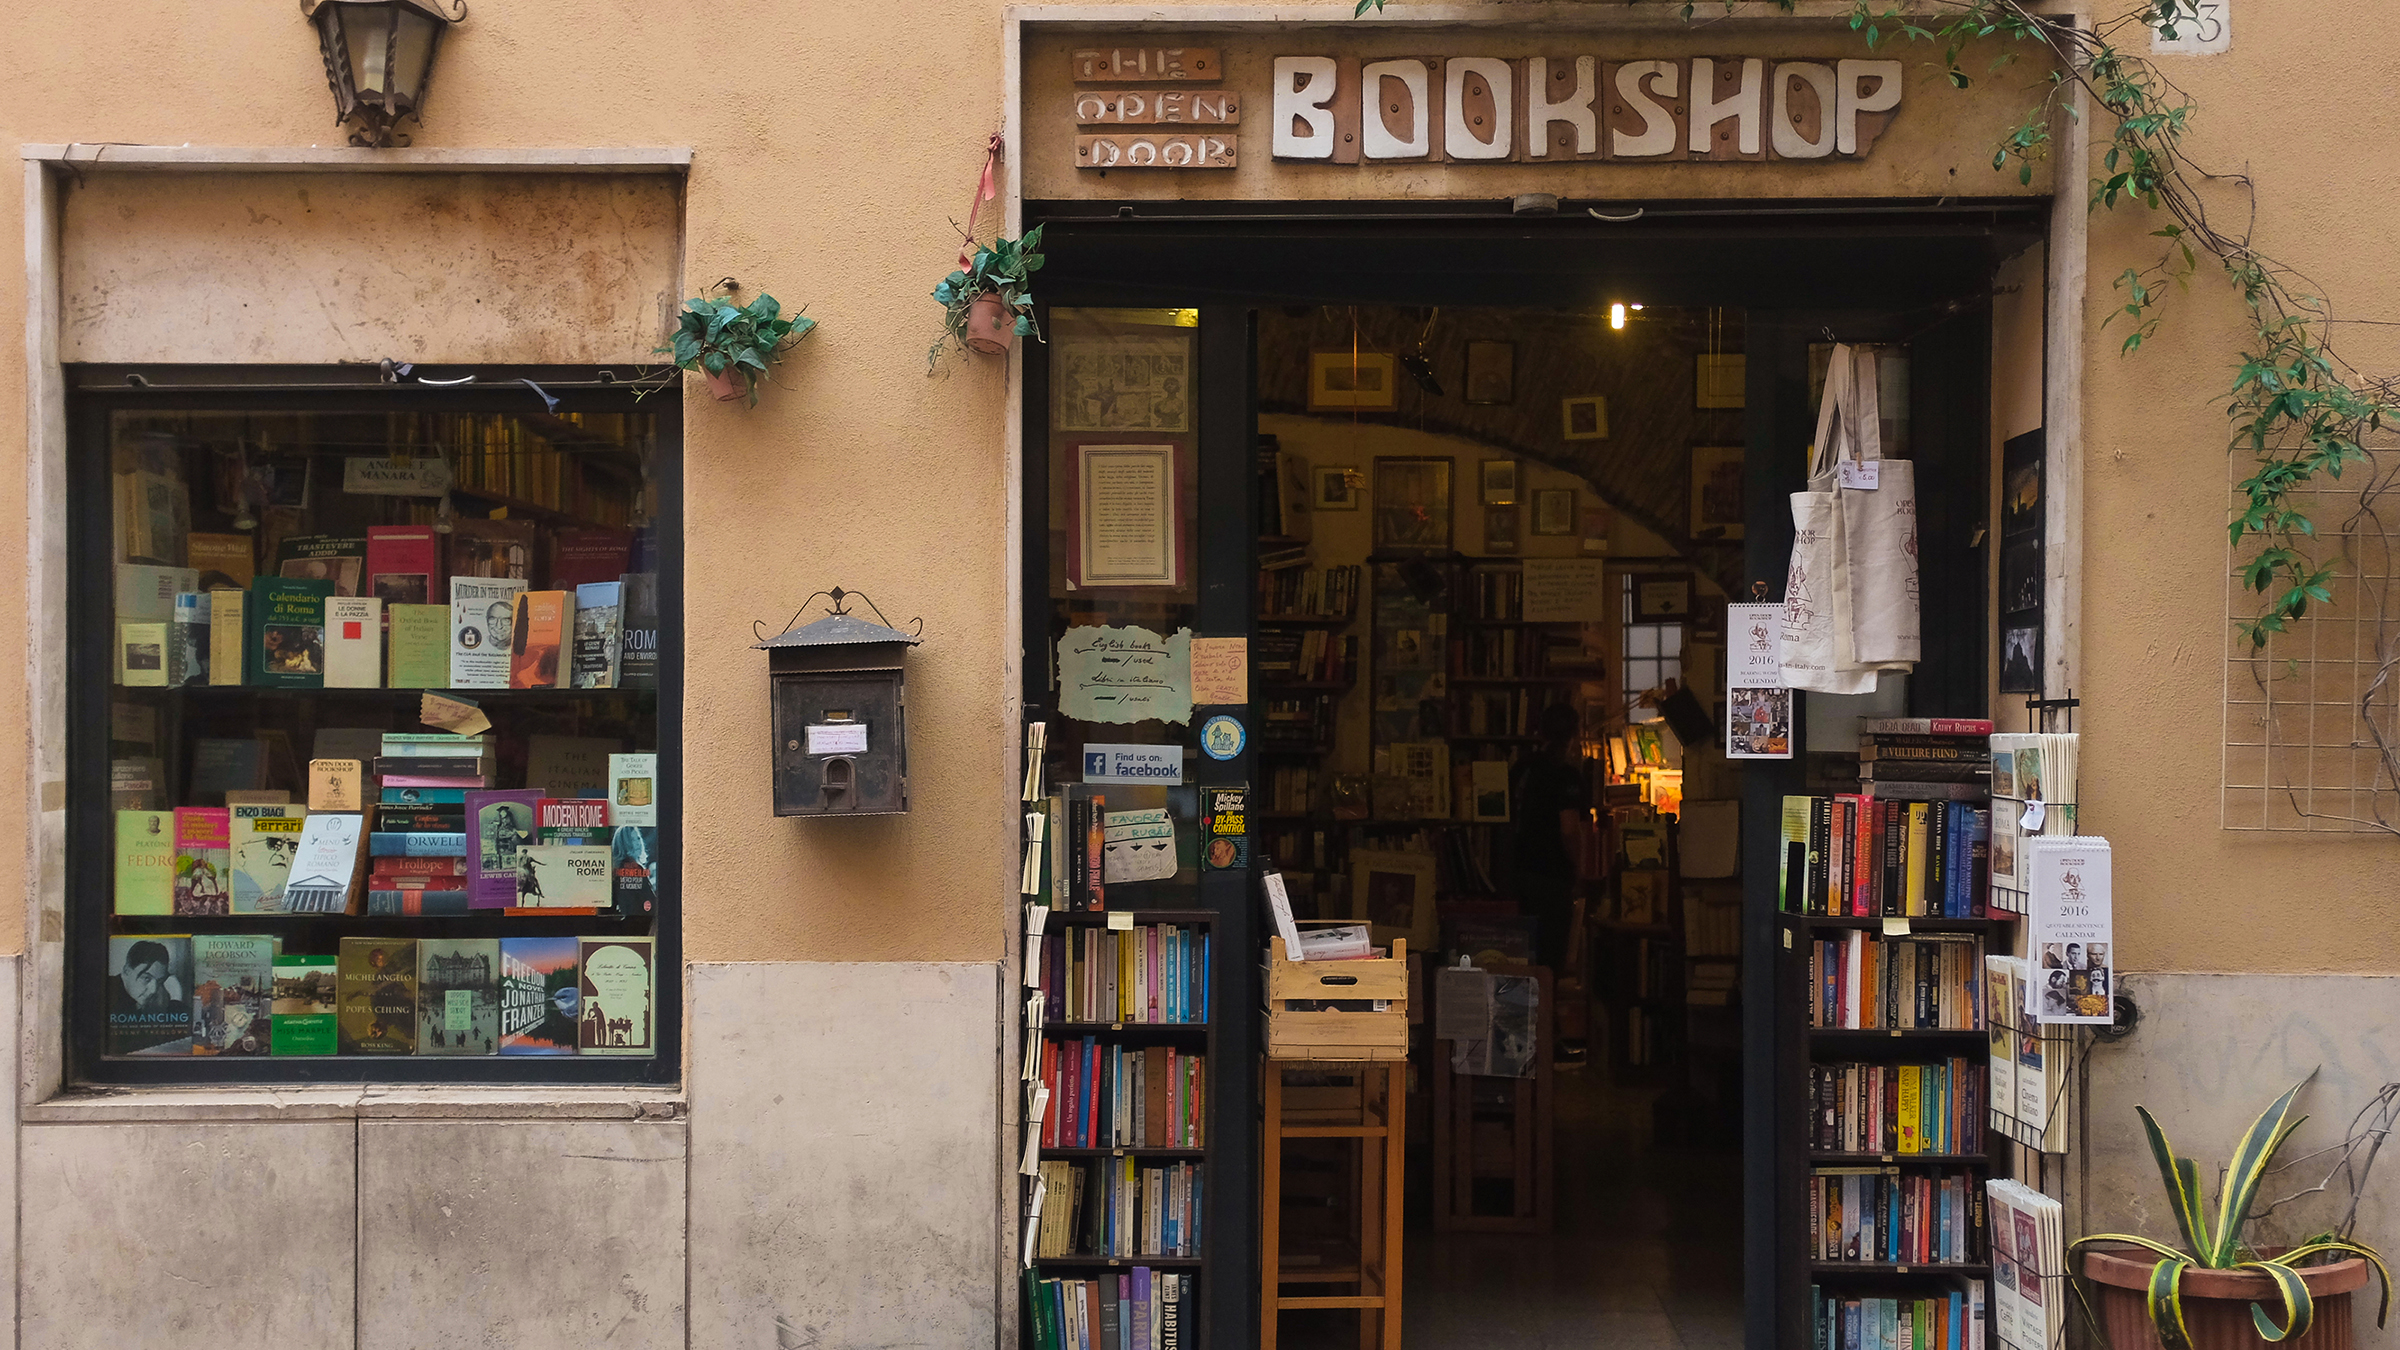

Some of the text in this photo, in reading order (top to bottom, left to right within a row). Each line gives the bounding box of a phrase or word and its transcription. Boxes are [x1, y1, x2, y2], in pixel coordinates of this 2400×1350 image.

[1076, 49, 1187, 78] THE
[1077, 93, 1226, 122] OPEN
[1272, 55, 1903, 160] BOOKSHOP
[1092, 137, 1228, 167] DOOR
[360, 471, 416, 480] MANARA
[297, 542, 356, 552] TRASTEVERE
[269, 592, 321, 603] Calendario
[455, 582, 499, 600] MURDER IN THE
[274, 603, 315, 615] di Roma
[624, 629, 657, 650] ROM
[1092, 637, 1151, 652] English books
[623, 652, 635, 660] AND
[1749, 655, 1774, 665] 2016
[1091, 671, 1164, 685] Libri italiano
[1901, 721, 1977, 733] DEAD KATHY REICHS
[565, 752, 587, 761] THE
[1115, 753, 1134, 762] Find
[1149, 754, 1163, 763] on:
[1888, 746, 1959, 759] VULTURE FUND
[548, 767, 601, 775] ITALIAN
[1114, 762, 1178, 777] facebook
[549, 780, 598, 789] CINEMA
[1216, 793, 1244, 803] Mickey
[236, 807, 259, 817] ENZO
[261, 807, 284, 817] BIAGI
[1214, 802, 1245, 812] Spillane
[1822, 801, 1831, 825] NEMESIS
[543, 805, 603, 827] MODERN ROME
[1110, 813, 1163, 824] FAVORE
[1215, 814, 1245, 824] BY-PASS
[1935, 801, 1945, 834] GENTLEMAN
[254, 820, 302, 831] Ferrari
[1213, 824, 1246, 833] CONTROL
[407, 836, 463, 847] ORWELL
[1831, 807, 1841, 868] ARES EXPRESS
[1886, 825, 1897, 868] ANDREW VACHSS
[1964, 833, 1972, 871] ARMISTEAD
[1897, 845, 1906, 864] CANADA
[400, 858, 444, 872] Trollope
[568, 859, 605, 867] ROMAN
[577, 868, 605, 876] ROME
[1088, 869, 1100, 891] FINALE
[2059, 905, 2089, 916] 2016
[208, 941, 254, 949] HOWARD
[205, 951, 257, 959] JACOBSON
[502, 951, 545, 988] FREEDOM
[345, 973, 412, 982] MICHELANGELO
[503, 979, 545, 992] A NOVEL
[501, 989, 545, 1009] JONATHAN
[110, 1012, 189, 1023] ROMANCING
[374, 1006, 410, 1014] CEILING
[1826, 1001, 1834, 1023] Midnight
[502, 1004, 545, 1035] FRANZEN
[1066, 1074, 1076, 1122] Un regalo perfetto
[1900, 1068, 1910, 1113] SNAP HAPPY
[2021, 1088, 2039, 1104] Cinema
[1907, 1092, 1917, 1119] WALKER
[2021, 1102, 2039, 1117] Italiano
[1809, 1189, 1817, 1235] MASQUERADE
[1974, 1201, 1983, 1228] LEOPARD
[1169, 1283, 1177, 1300] JAMES
[1133, 1301, 1147, 1350] PARKY
[1163, 1304, 1177, 1350] HABITUS
[2021, 1316, 2043, 1338] VINTAGE
[1865, 1321, 1876, 1346] Night In
[2021, 1330, 2045, 1350] POSTERS
